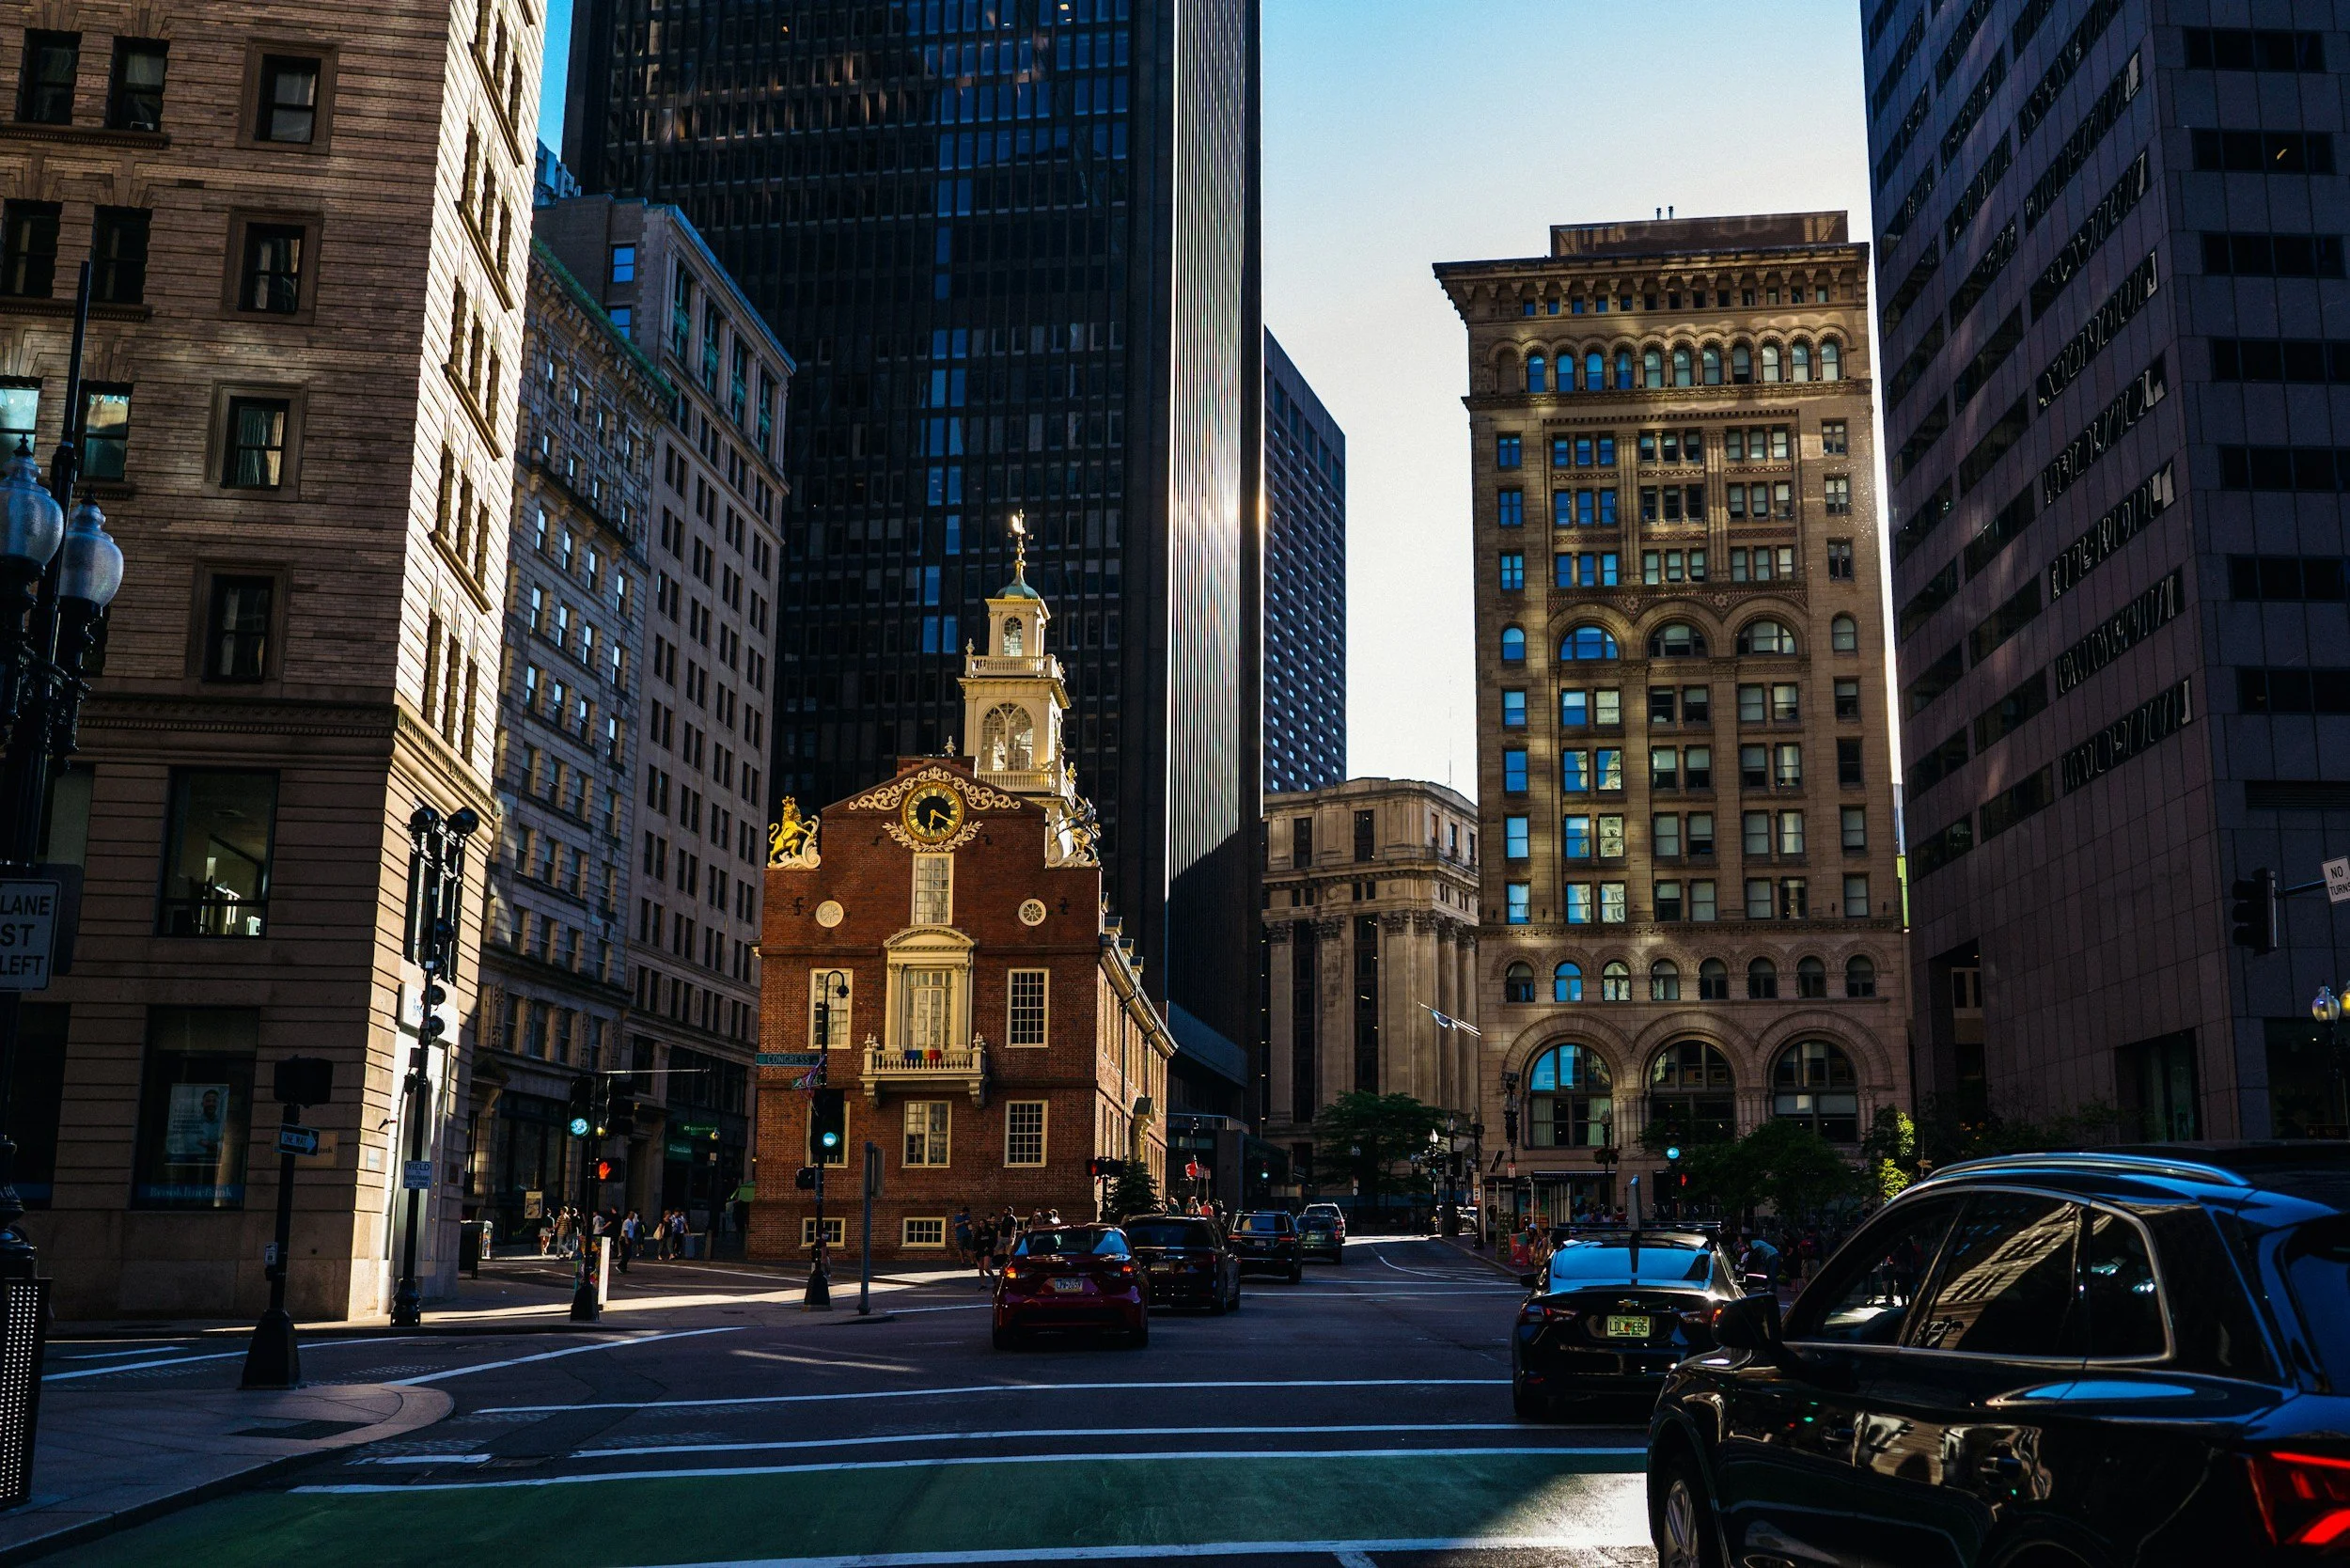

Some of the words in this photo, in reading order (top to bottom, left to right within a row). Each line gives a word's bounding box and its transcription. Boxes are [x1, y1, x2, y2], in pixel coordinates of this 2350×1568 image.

[2330, 866, 2343, 879] NO
[0, 895, 51, 916] LANE
[0, 954, 45, 975] LEFT
[767, 1055, 810, 1064] CONGRESS
[284, 1133, 295, 1144] ONE
[296, 1135, 308, 1147] WAY
[1610, 1321, 1624, 1332] LDL
